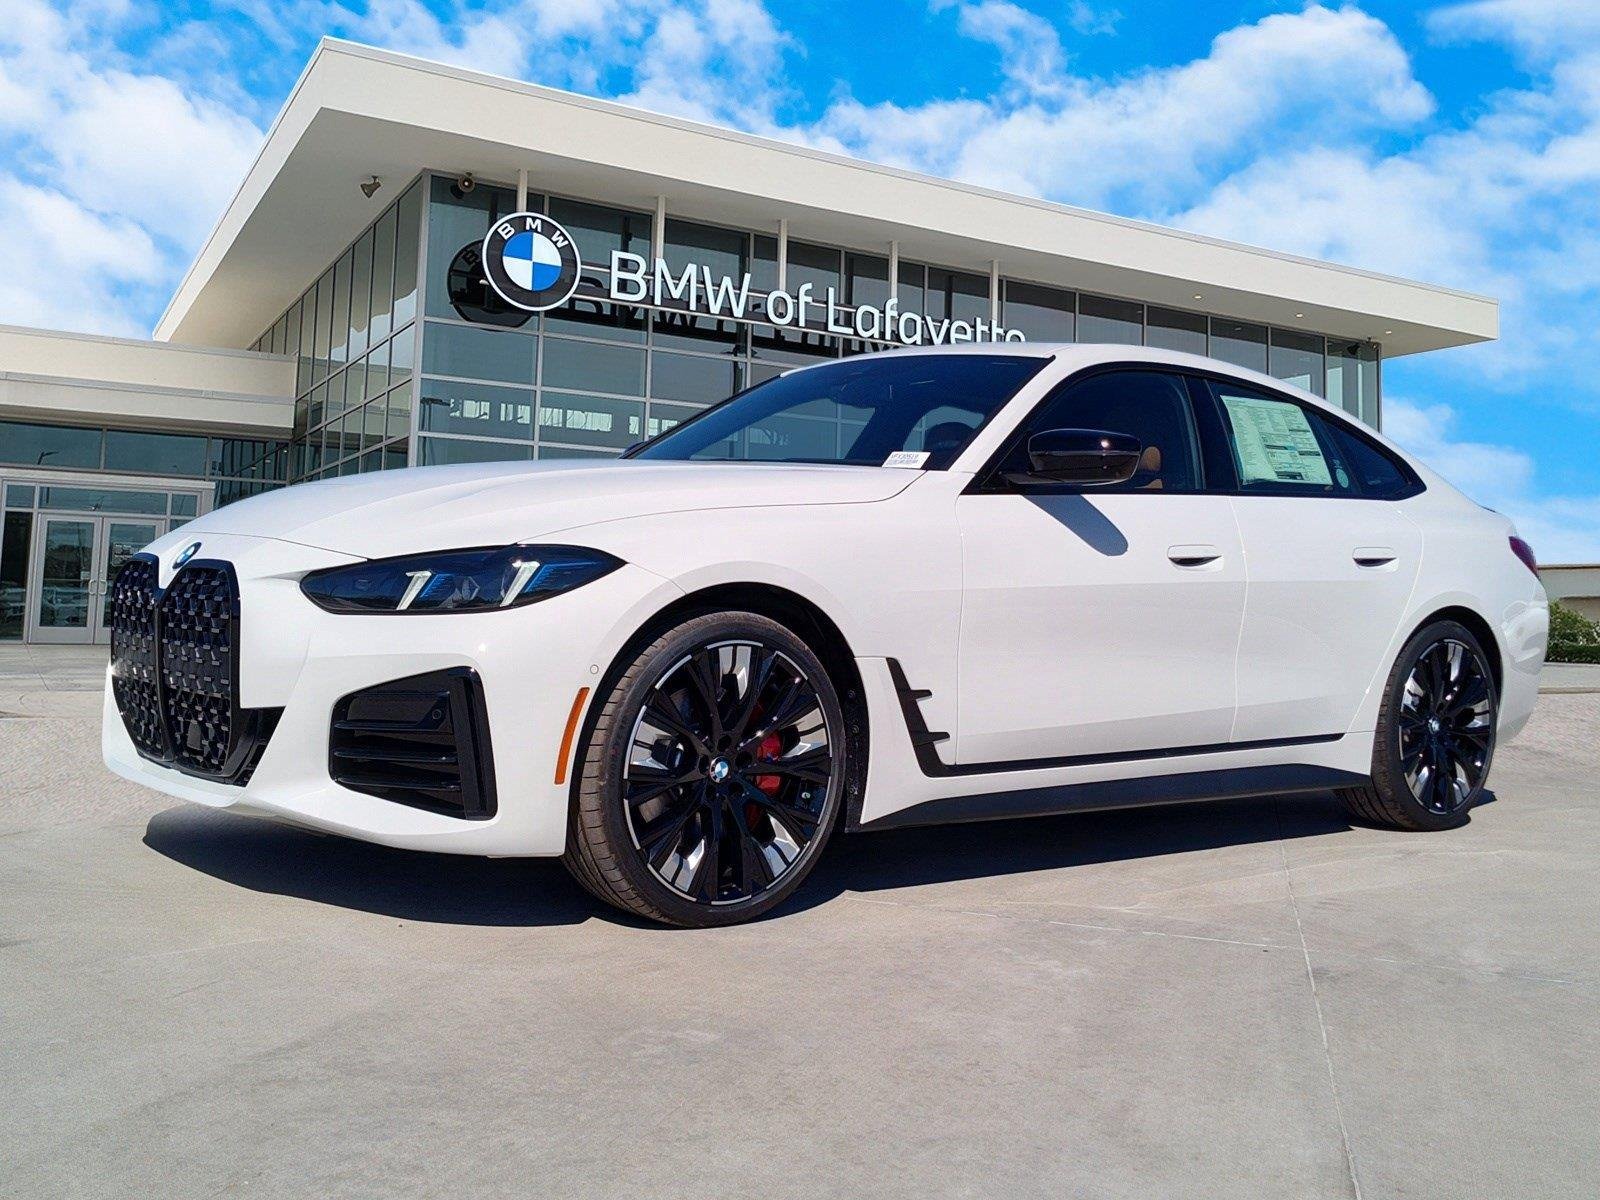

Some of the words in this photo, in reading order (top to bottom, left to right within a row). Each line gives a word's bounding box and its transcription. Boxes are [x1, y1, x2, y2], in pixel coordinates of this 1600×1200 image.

[497, 217, 569, 248] BMW
[610, 250, 751, 318] BMW
[767, 282, 813, 327] of
